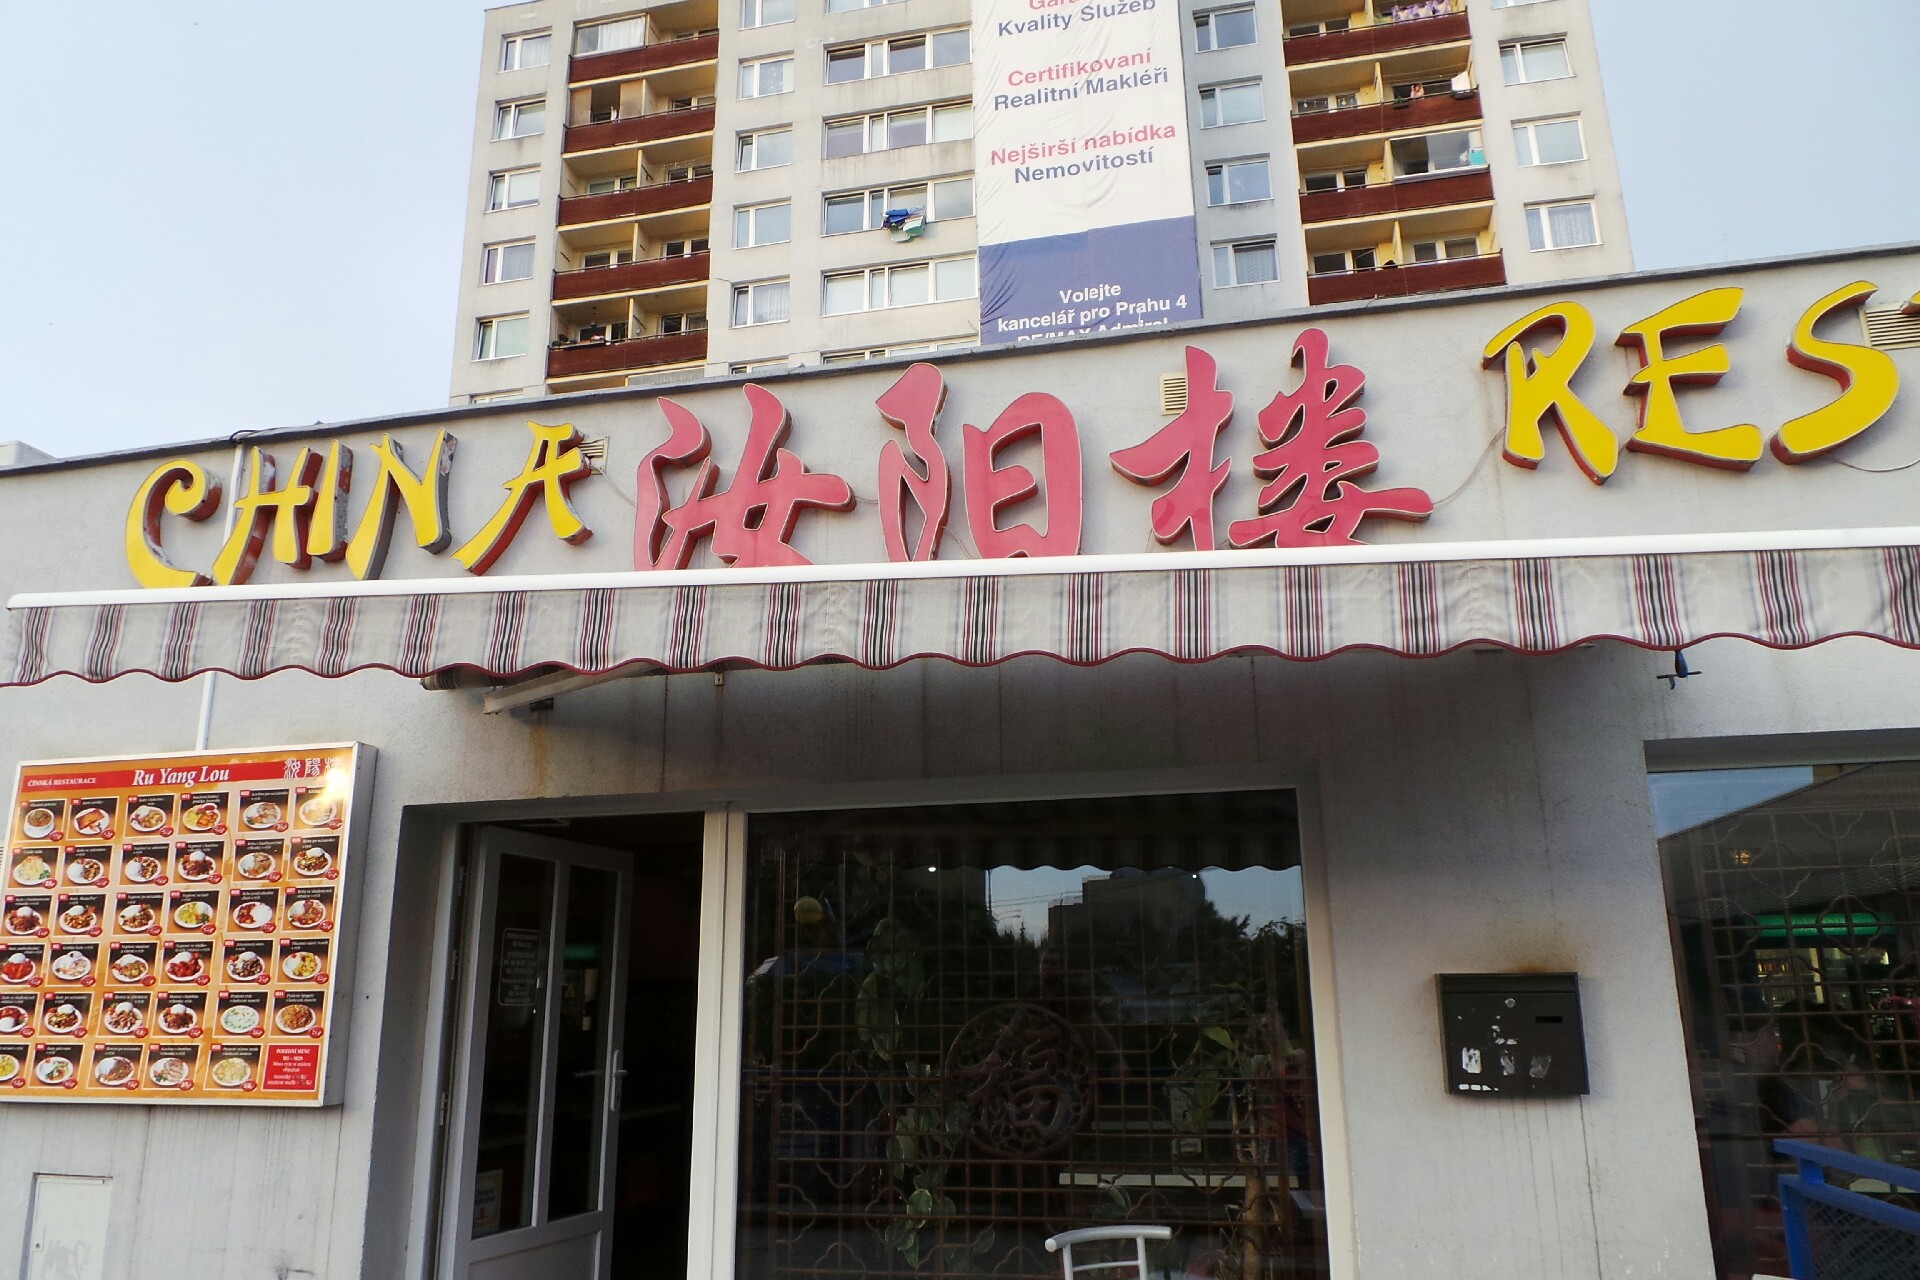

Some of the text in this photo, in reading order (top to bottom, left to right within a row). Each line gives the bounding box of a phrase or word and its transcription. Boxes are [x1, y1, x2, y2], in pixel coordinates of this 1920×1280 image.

[998, 0, 1156, 37] Kvality Služeb
[1008, 47, 1152, 86] Certifikovaní
[994, 67, 1168, 111] Realitní Makléři
[990, 124, 1176, 165] Nejširší nabídka
[1014, 146, 1154, 183] Nemovitostí
[997, 309, 1076, 332] kancelář
[1080, 306, 1110, 326] pro
[1116, 298, 1171, 316] Prahu
[1175, 294, 1188, 309] 4
[1059, 284, 1122, 304] Volejte
[1482, 279, 1920, 484] RES
[125, 420, 596, 588] CHINA
[53, 777, 96, 786] RESTAURACE
[131, 769, 155, 786] Ru
[159, 768, 197, 788] Yang
[198, 766, 230, 782] Lou
